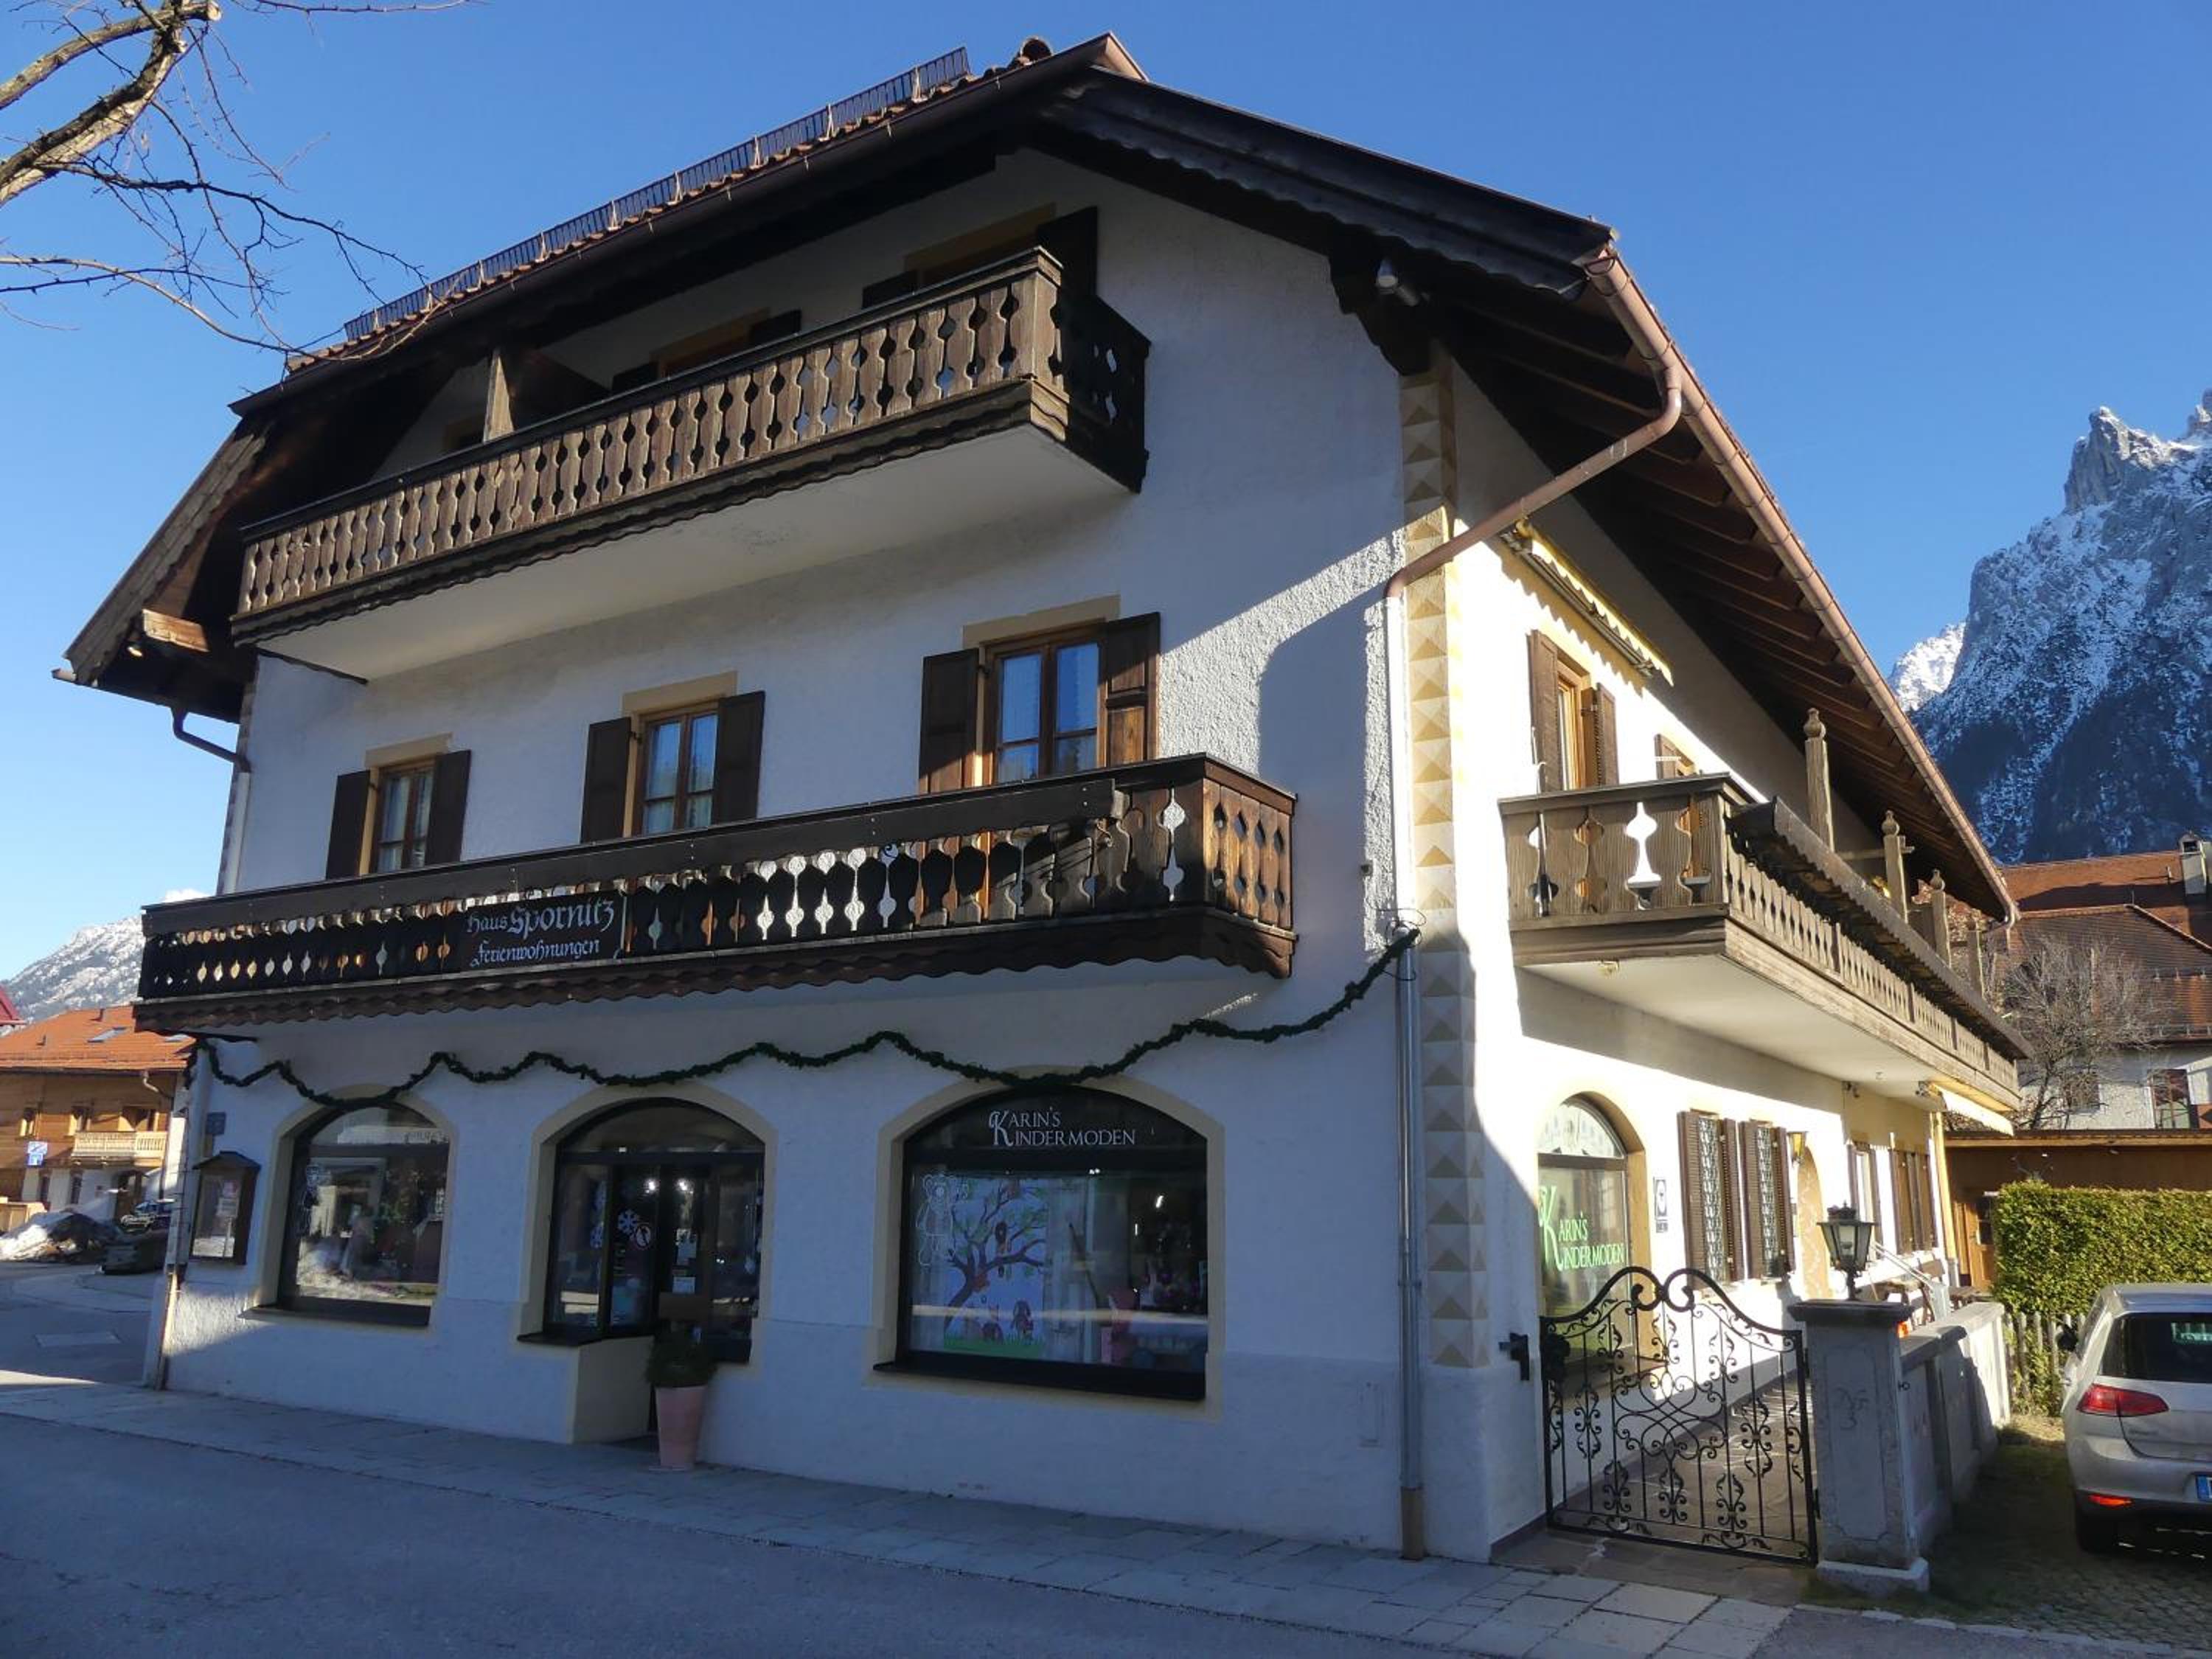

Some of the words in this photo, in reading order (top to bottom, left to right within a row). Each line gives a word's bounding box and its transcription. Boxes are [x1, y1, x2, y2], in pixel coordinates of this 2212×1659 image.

[466, 911, 509, 933] Haus
[507, 898, 614, 940] Spornitz
[469, 939, 600, 967] Ferienwohnungen
